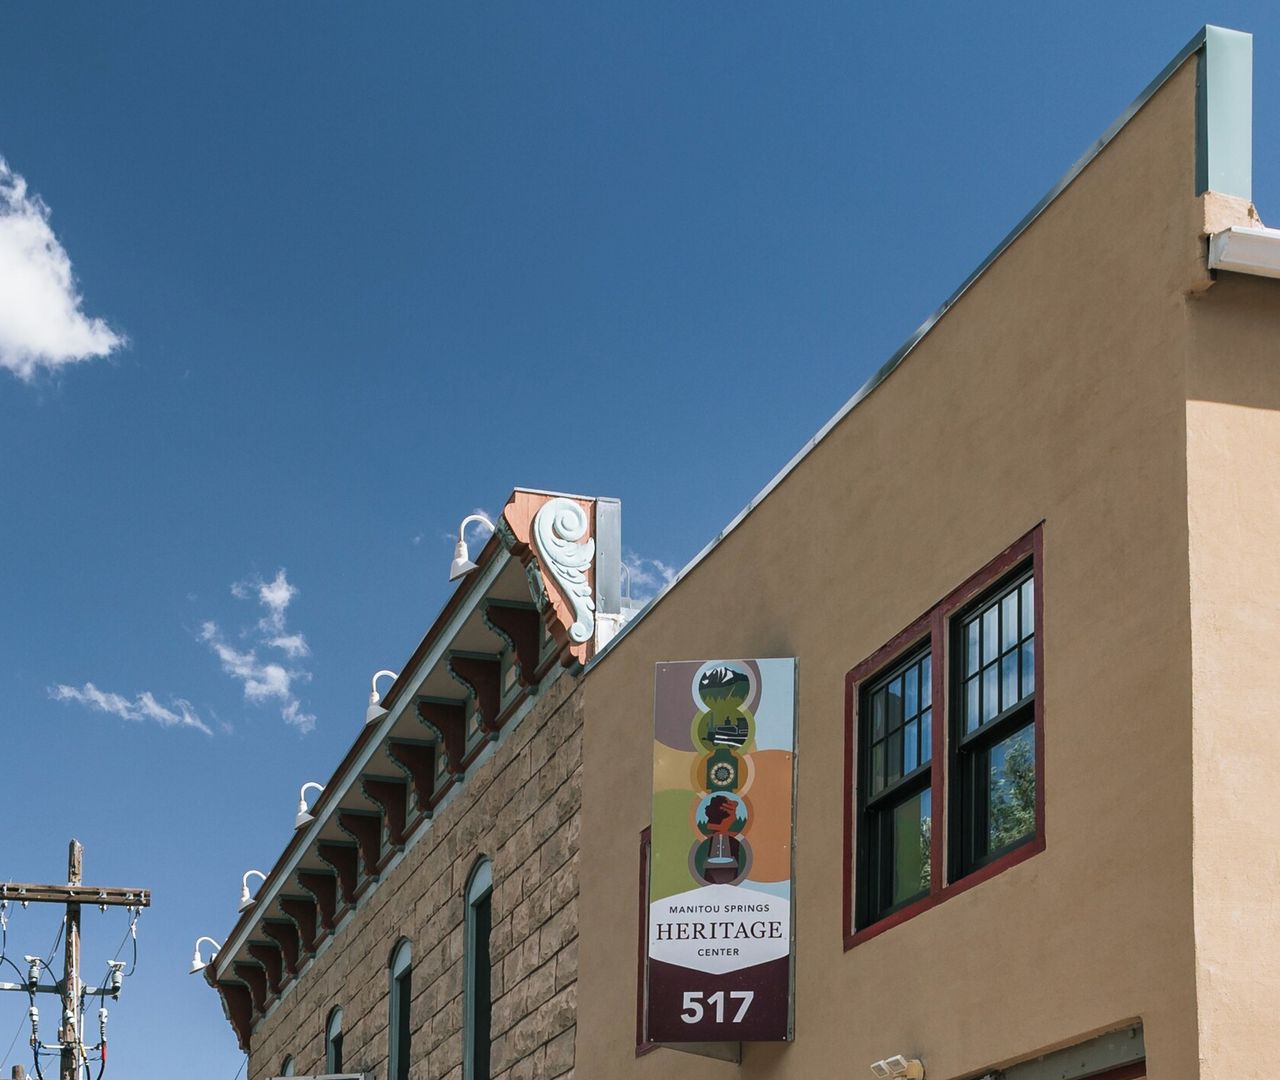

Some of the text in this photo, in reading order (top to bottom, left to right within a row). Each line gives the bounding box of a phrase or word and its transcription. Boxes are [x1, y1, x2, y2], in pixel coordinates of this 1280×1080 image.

[669, 904, 770, 914] MANITOU SPRINGS
[656, 921, 783, 941] HERITAGE
[697, 948, 740, 957] CENTER
[680, 991, 754, 1024] 517
